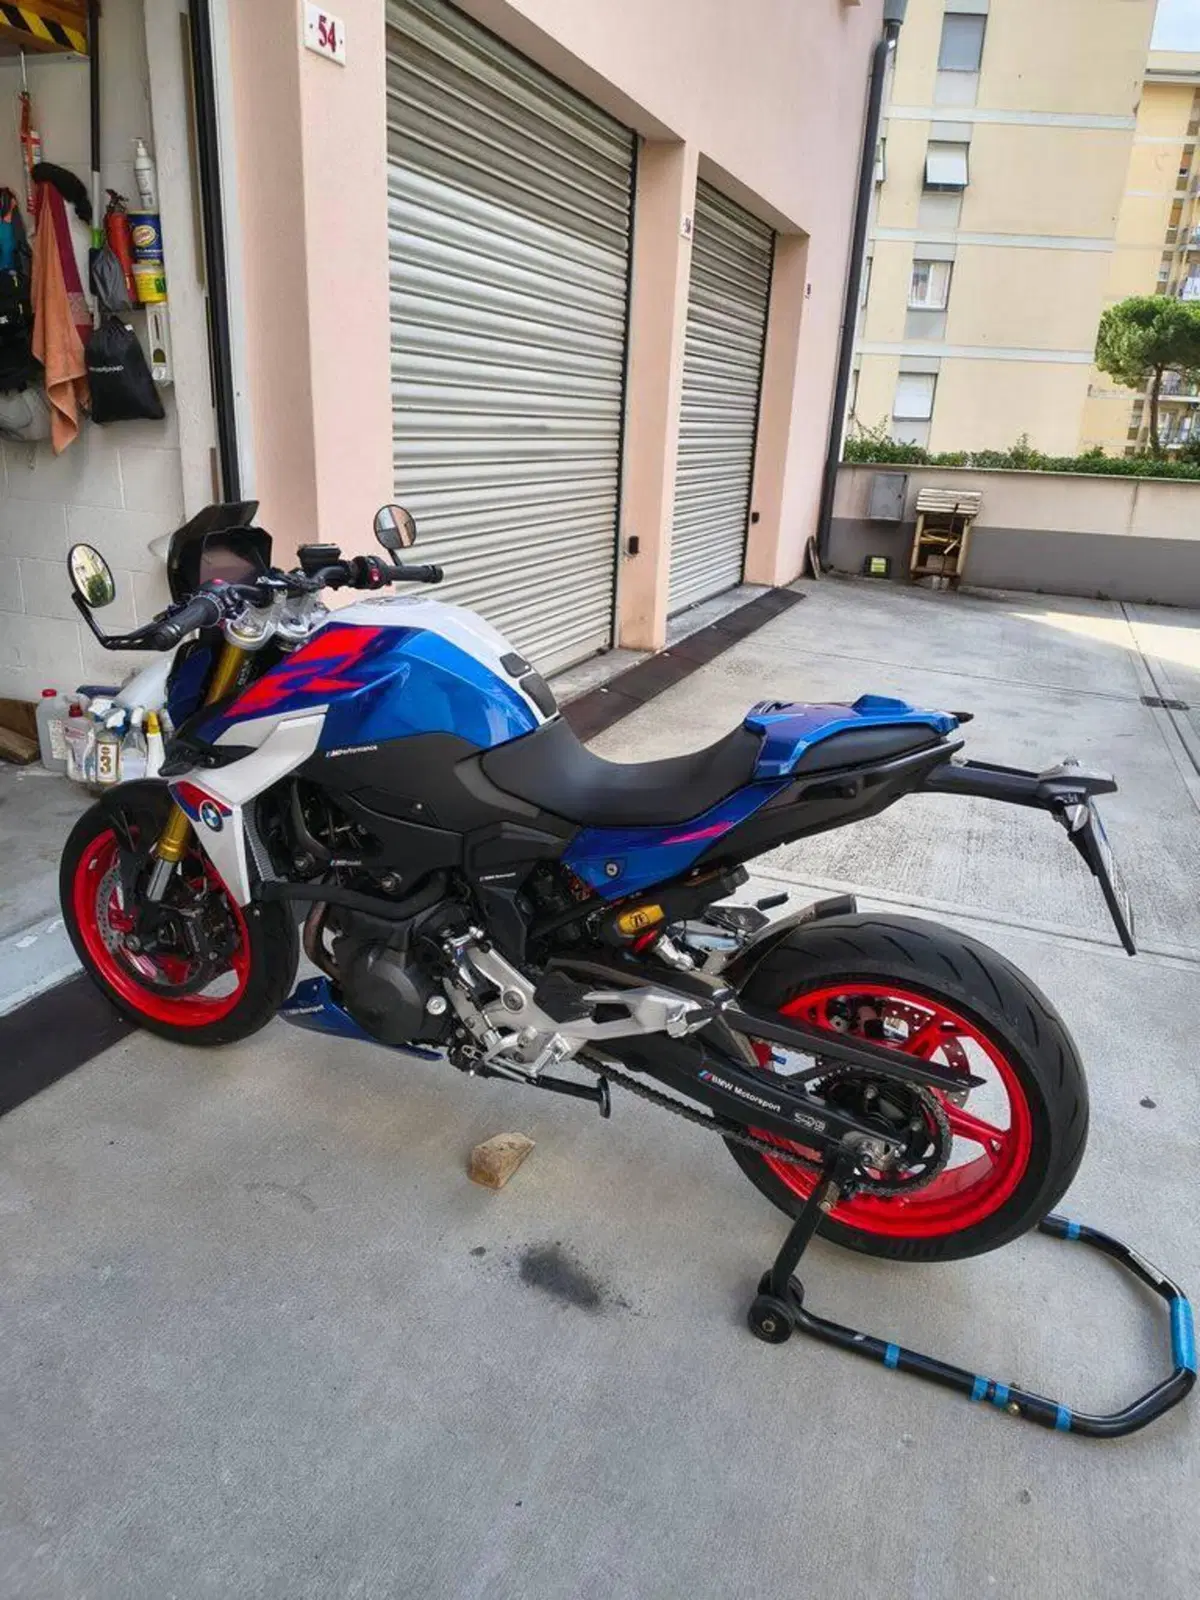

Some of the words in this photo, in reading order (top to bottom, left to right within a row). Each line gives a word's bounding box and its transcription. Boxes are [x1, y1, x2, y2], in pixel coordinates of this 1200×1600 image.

[318, 14, 336, 53] 54
[711, 1075, 732, 1091] BMW
[734, 1086, 781, 1112] Motorsport
